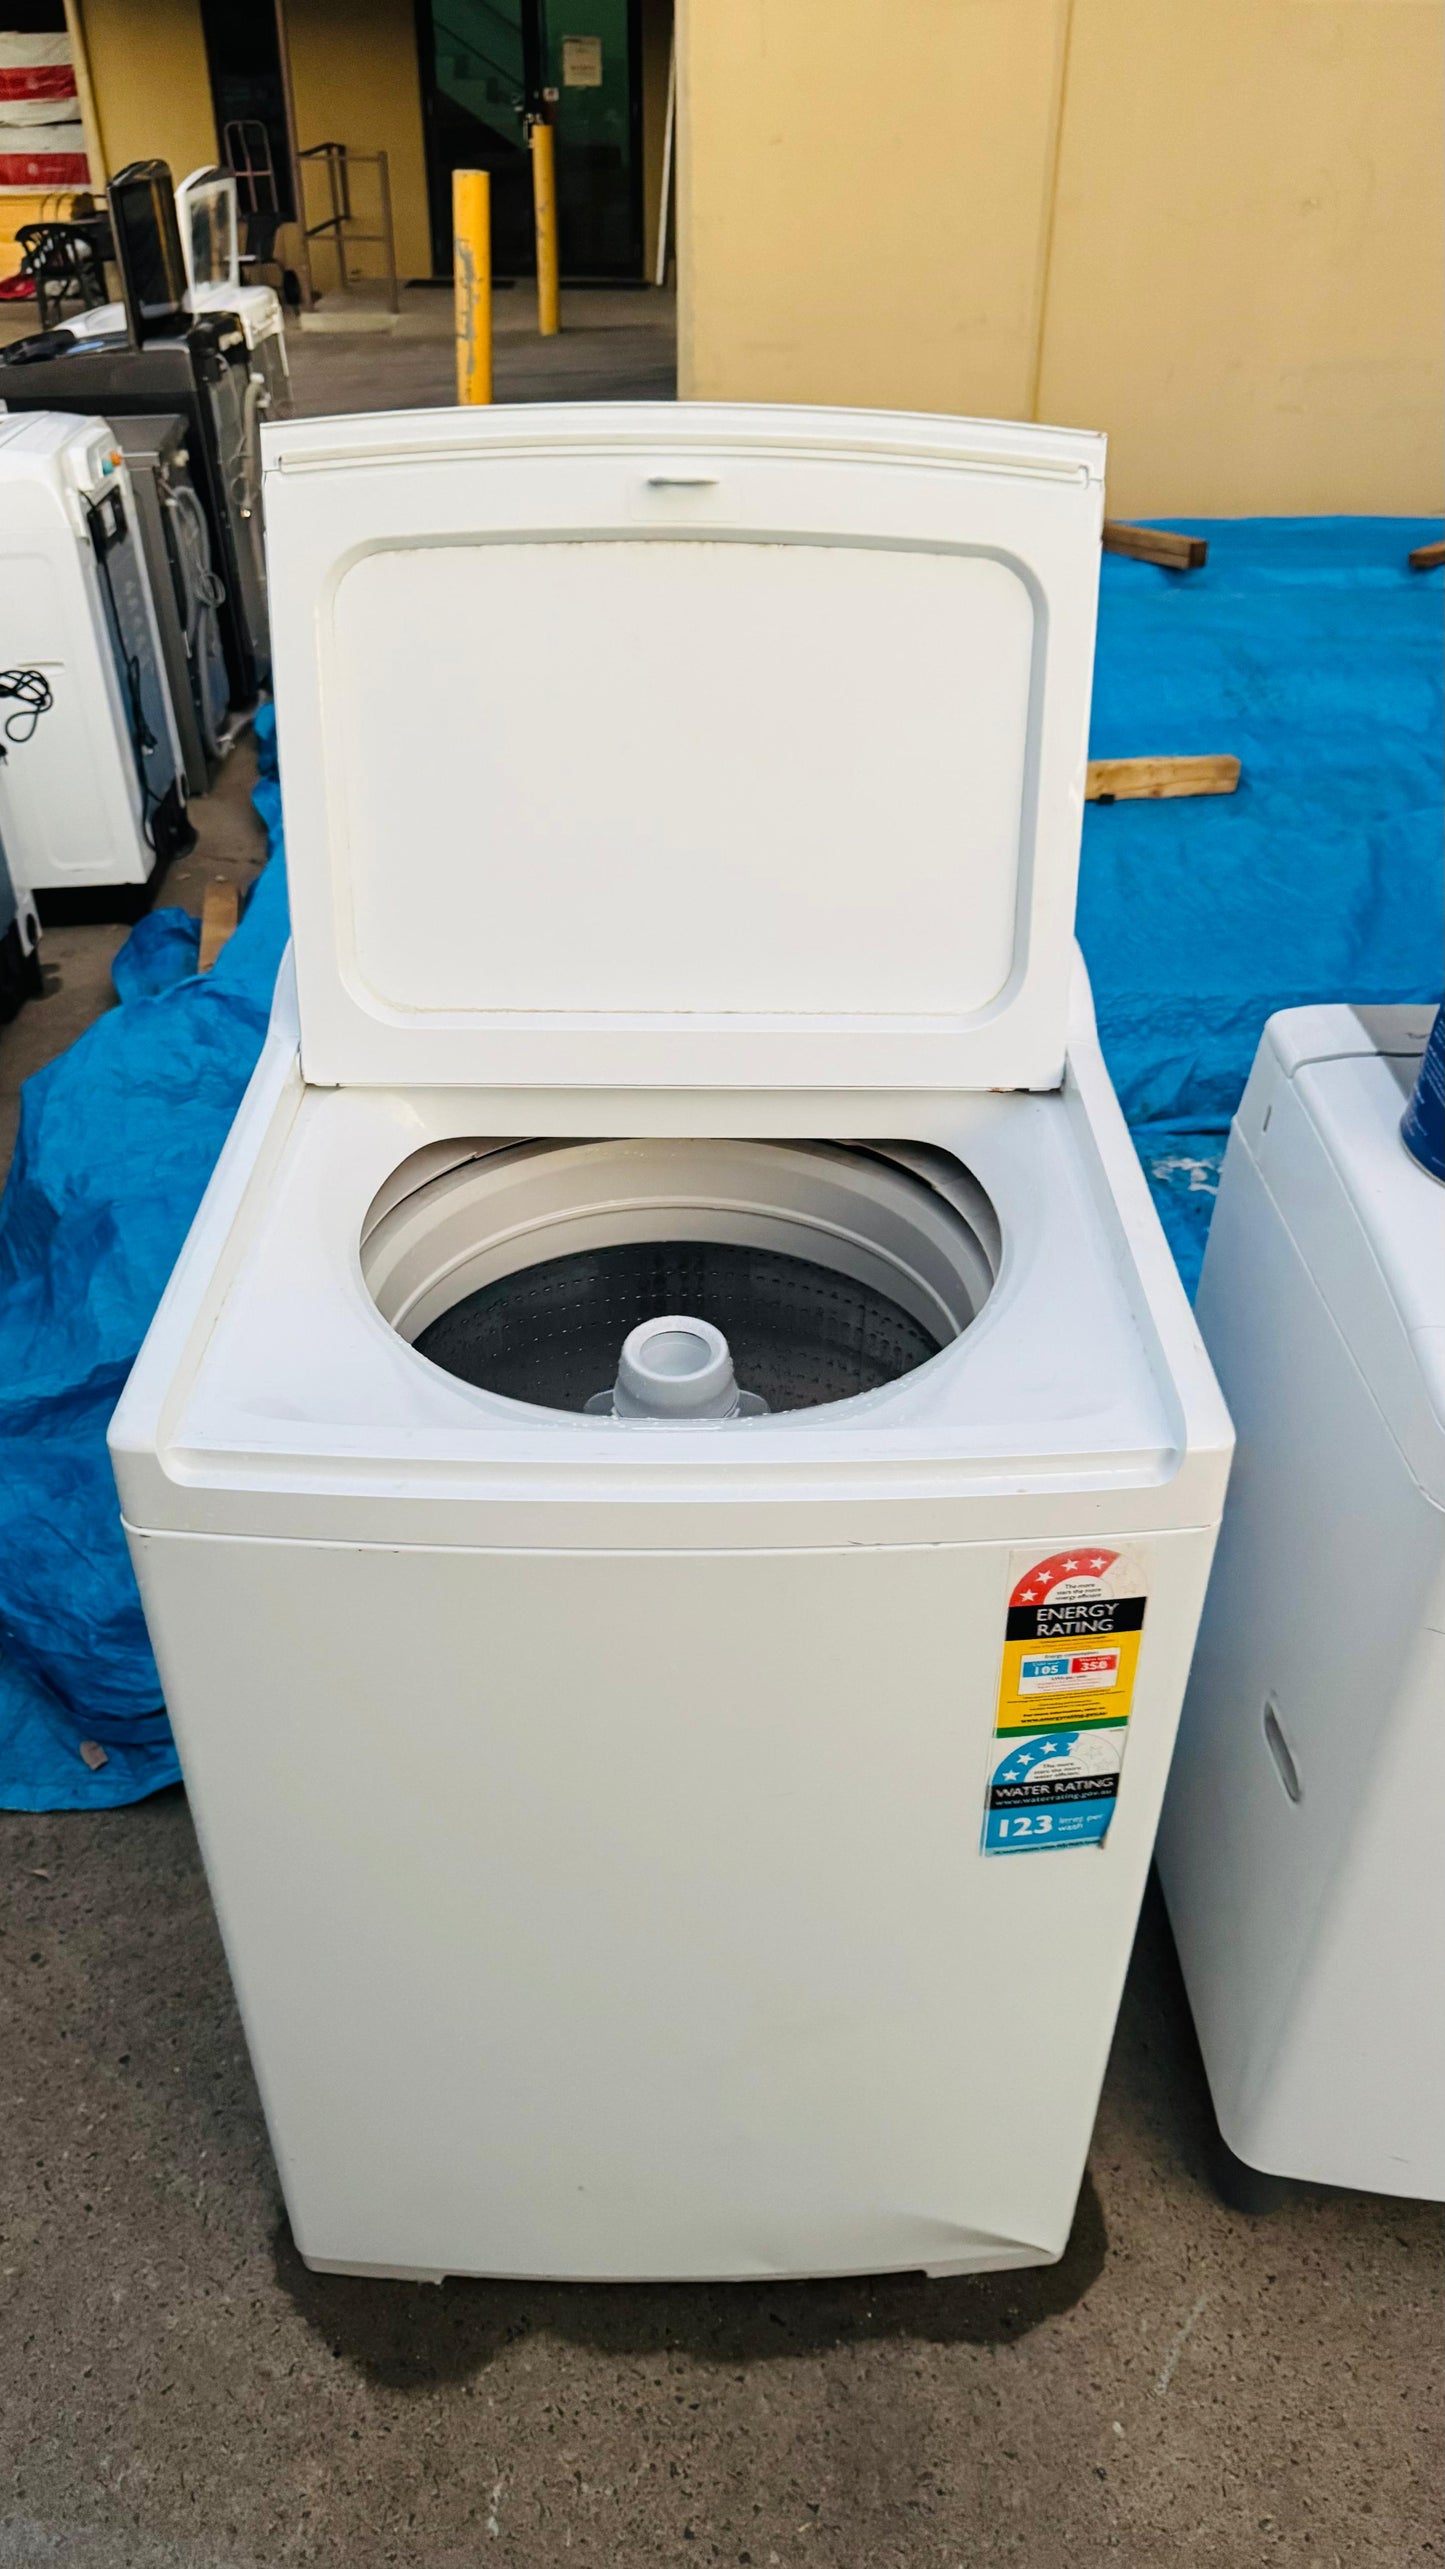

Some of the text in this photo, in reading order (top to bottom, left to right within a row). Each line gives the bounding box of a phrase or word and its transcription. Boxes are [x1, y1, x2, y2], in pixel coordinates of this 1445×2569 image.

[1036, 1603, 1119, 1621] ENERGY
[1036, 1619, 1114, 1636] RATING
[1034, 1665, 1059, 1675] 105
[995, 1777, 1113, 1797] WATER RATING
[995, 1790, 1112, 1805] www.waterrating.gov.au
[999, 1815, 1052, 1837] 123
